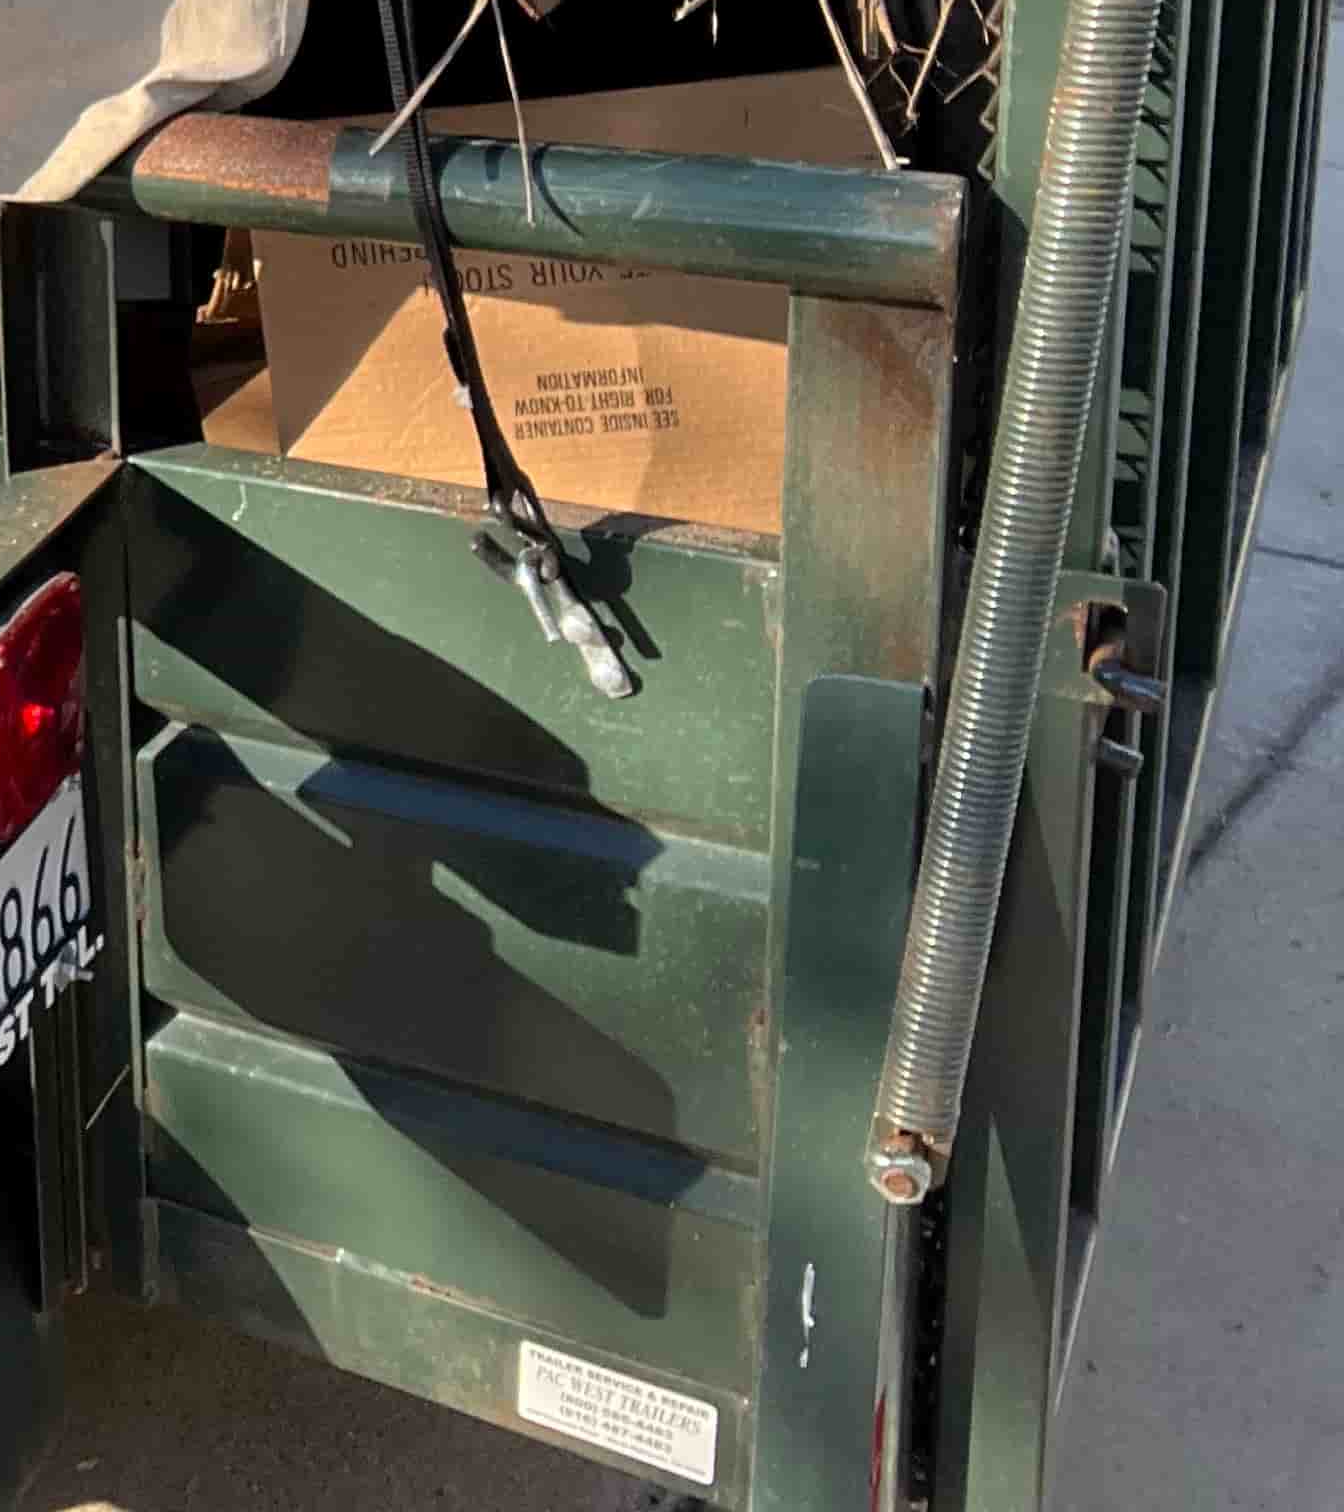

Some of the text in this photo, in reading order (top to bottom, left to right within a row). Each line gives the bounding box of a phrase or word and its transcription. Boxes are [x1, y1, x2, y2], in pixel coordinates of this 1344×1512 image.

[536, 367, 645, 391] INFORMATION
[644, 385, 673, 407] FOR
[513, 408, 680, 441] SEE INSIDE CONTAINER
[529, 1348, 584, 1376] TRAILER
[587, 1366, 643, 1395] SERVICE
[661, 1394, 711, 1420] REPAIR
[536, 1365, 563, 1386] PAC
[570, 1375, 613, 1404] WEST
[620, 1393, 703, 1434] TRAILERS
